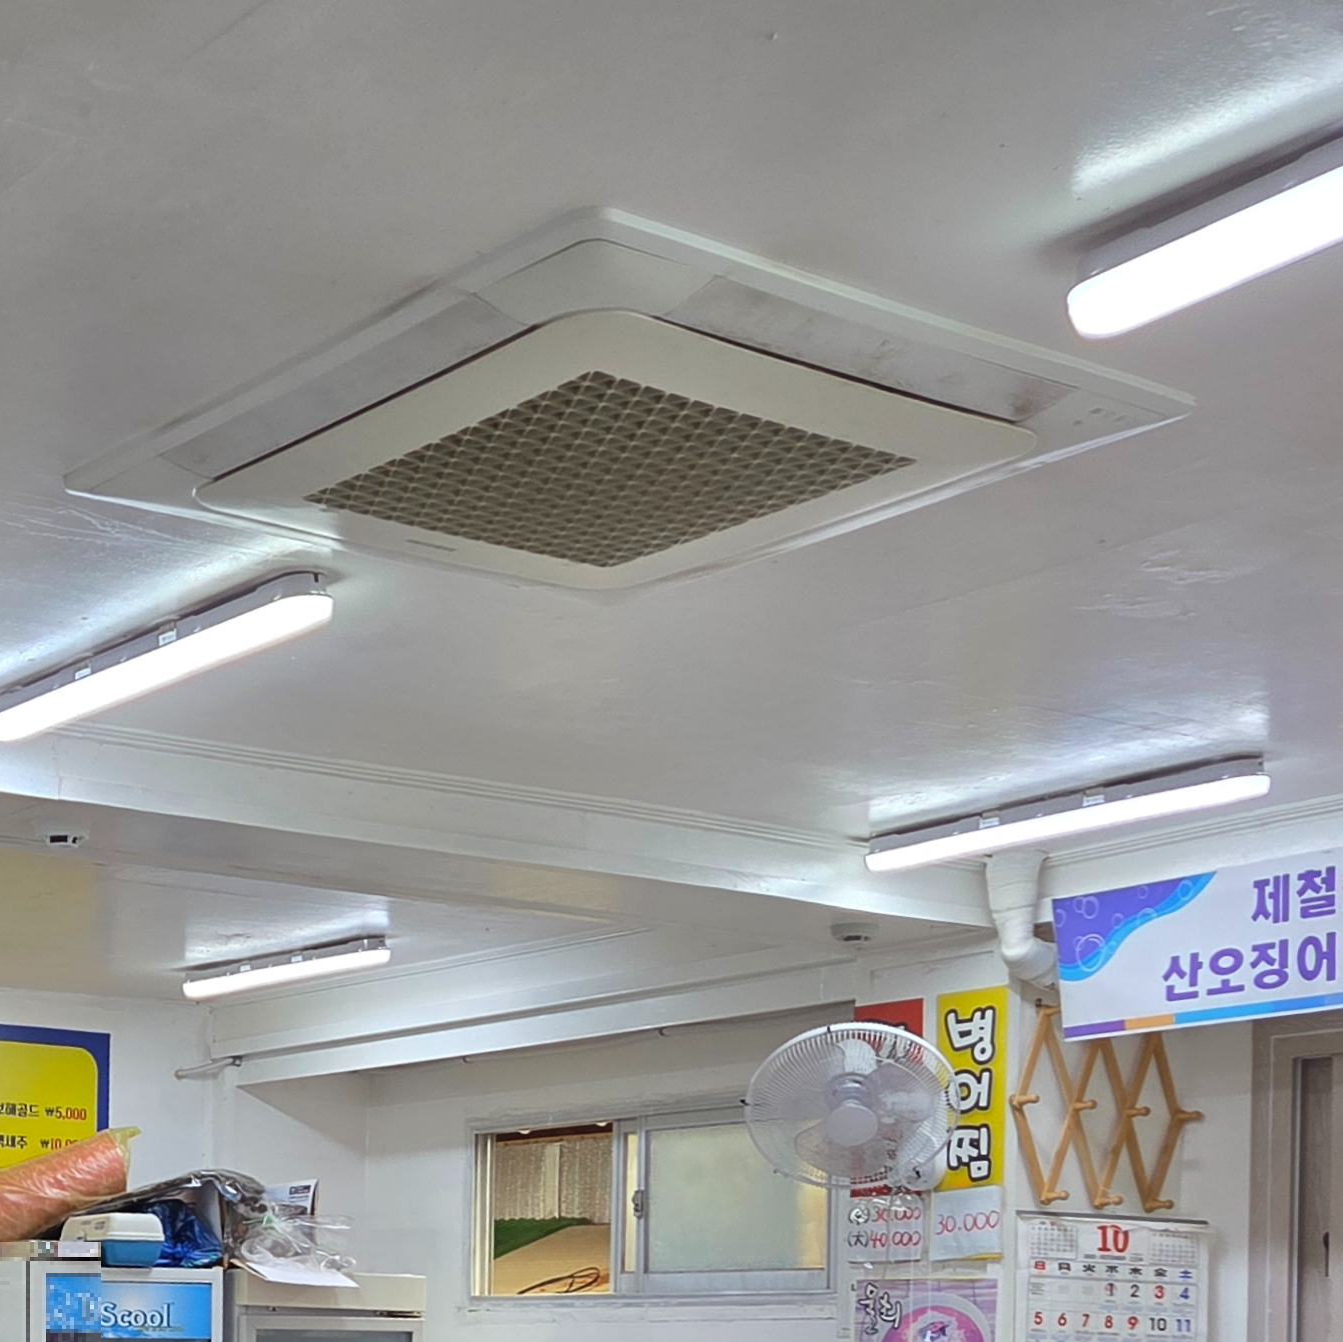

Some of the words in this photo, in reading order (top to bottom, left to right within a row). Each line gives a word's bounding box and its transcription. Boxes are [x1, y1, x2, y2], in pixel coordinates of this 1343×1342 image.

[1251, 866, 1336, 924] 제철
[1162, 932, 1337, 1002] 산오징어
[45, 1107, 87, 1121] ₩5,000
[935, 1210, 1000, 1236] 30.000
[1097, 1224, 1130, 1253] 10
[1130, 1284, 1140, 1298] 2
[1153, 1285, 1166, 1300] 3
[1179, 1287, 1190, 1300] 4
[1034, 1312, 1043, 1326] 5
[1058, 1313, 1066, 1327] 6
[1081, 1314, 1090, 1328] 7
[1104, 1315, 1113, 1329] 8
[1127, 1316, 1138, 1330] 9
[1149, 1317, 1167, 1332] 10
[1176, 1318, 1191, 1332] 11
